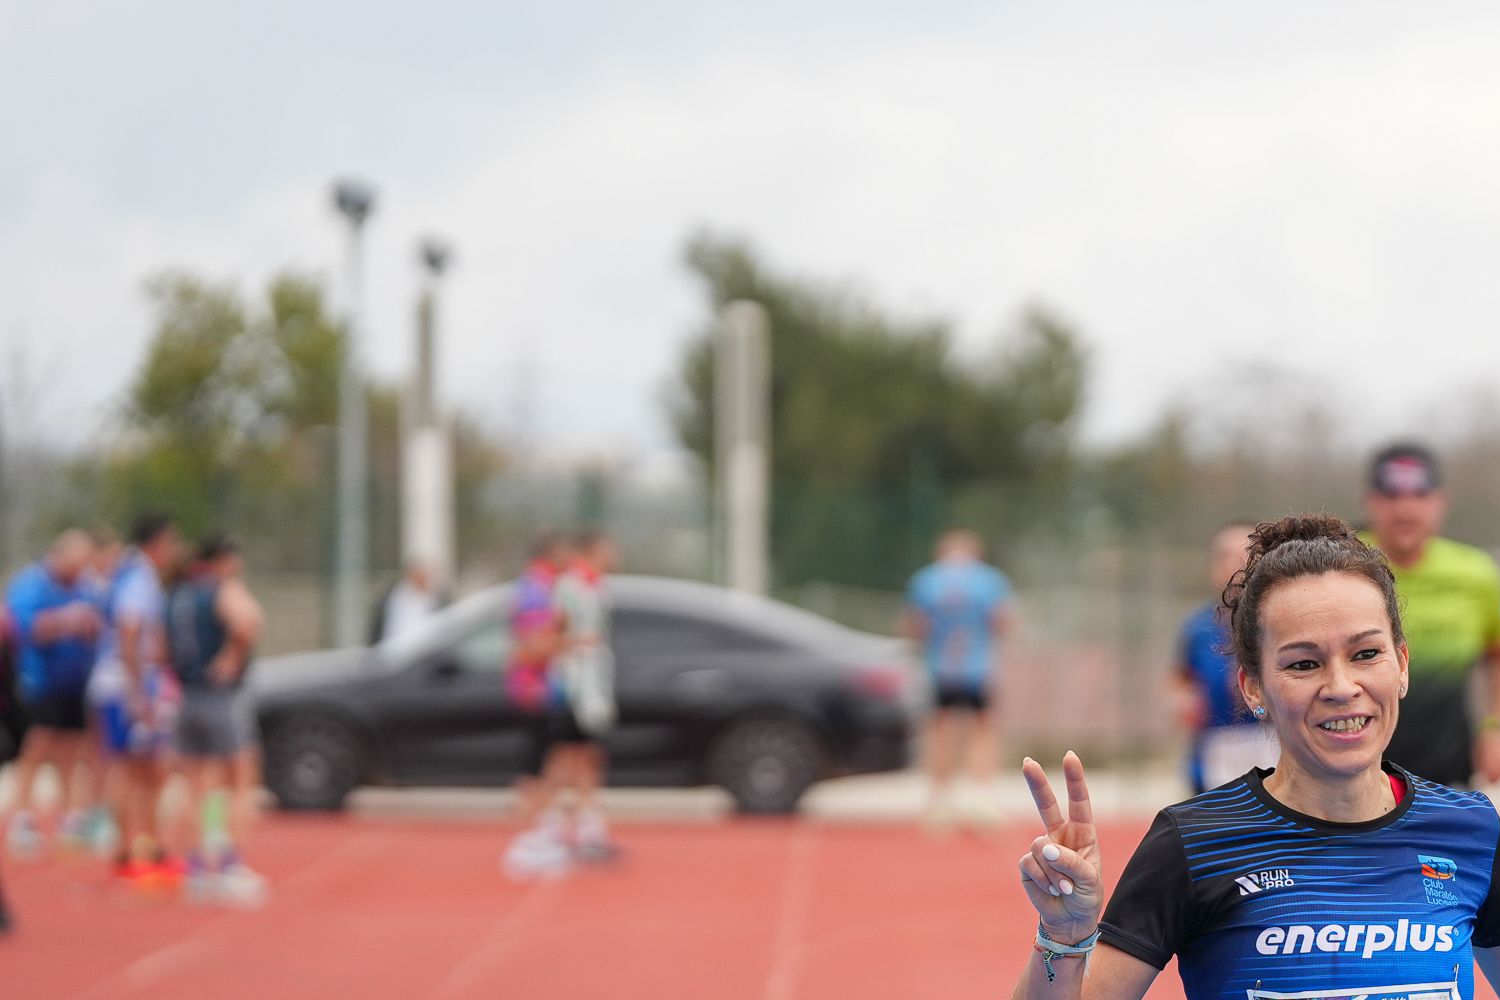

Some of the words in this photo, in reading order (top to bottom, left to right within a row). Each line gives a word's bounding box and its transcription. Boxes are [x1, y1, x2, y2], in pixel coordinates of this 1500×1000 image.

[1260, 869, 1289, 882] RUN
[1422, 877, 1444, 890] Club
[1255, 918, 1454, 959] enerplus
